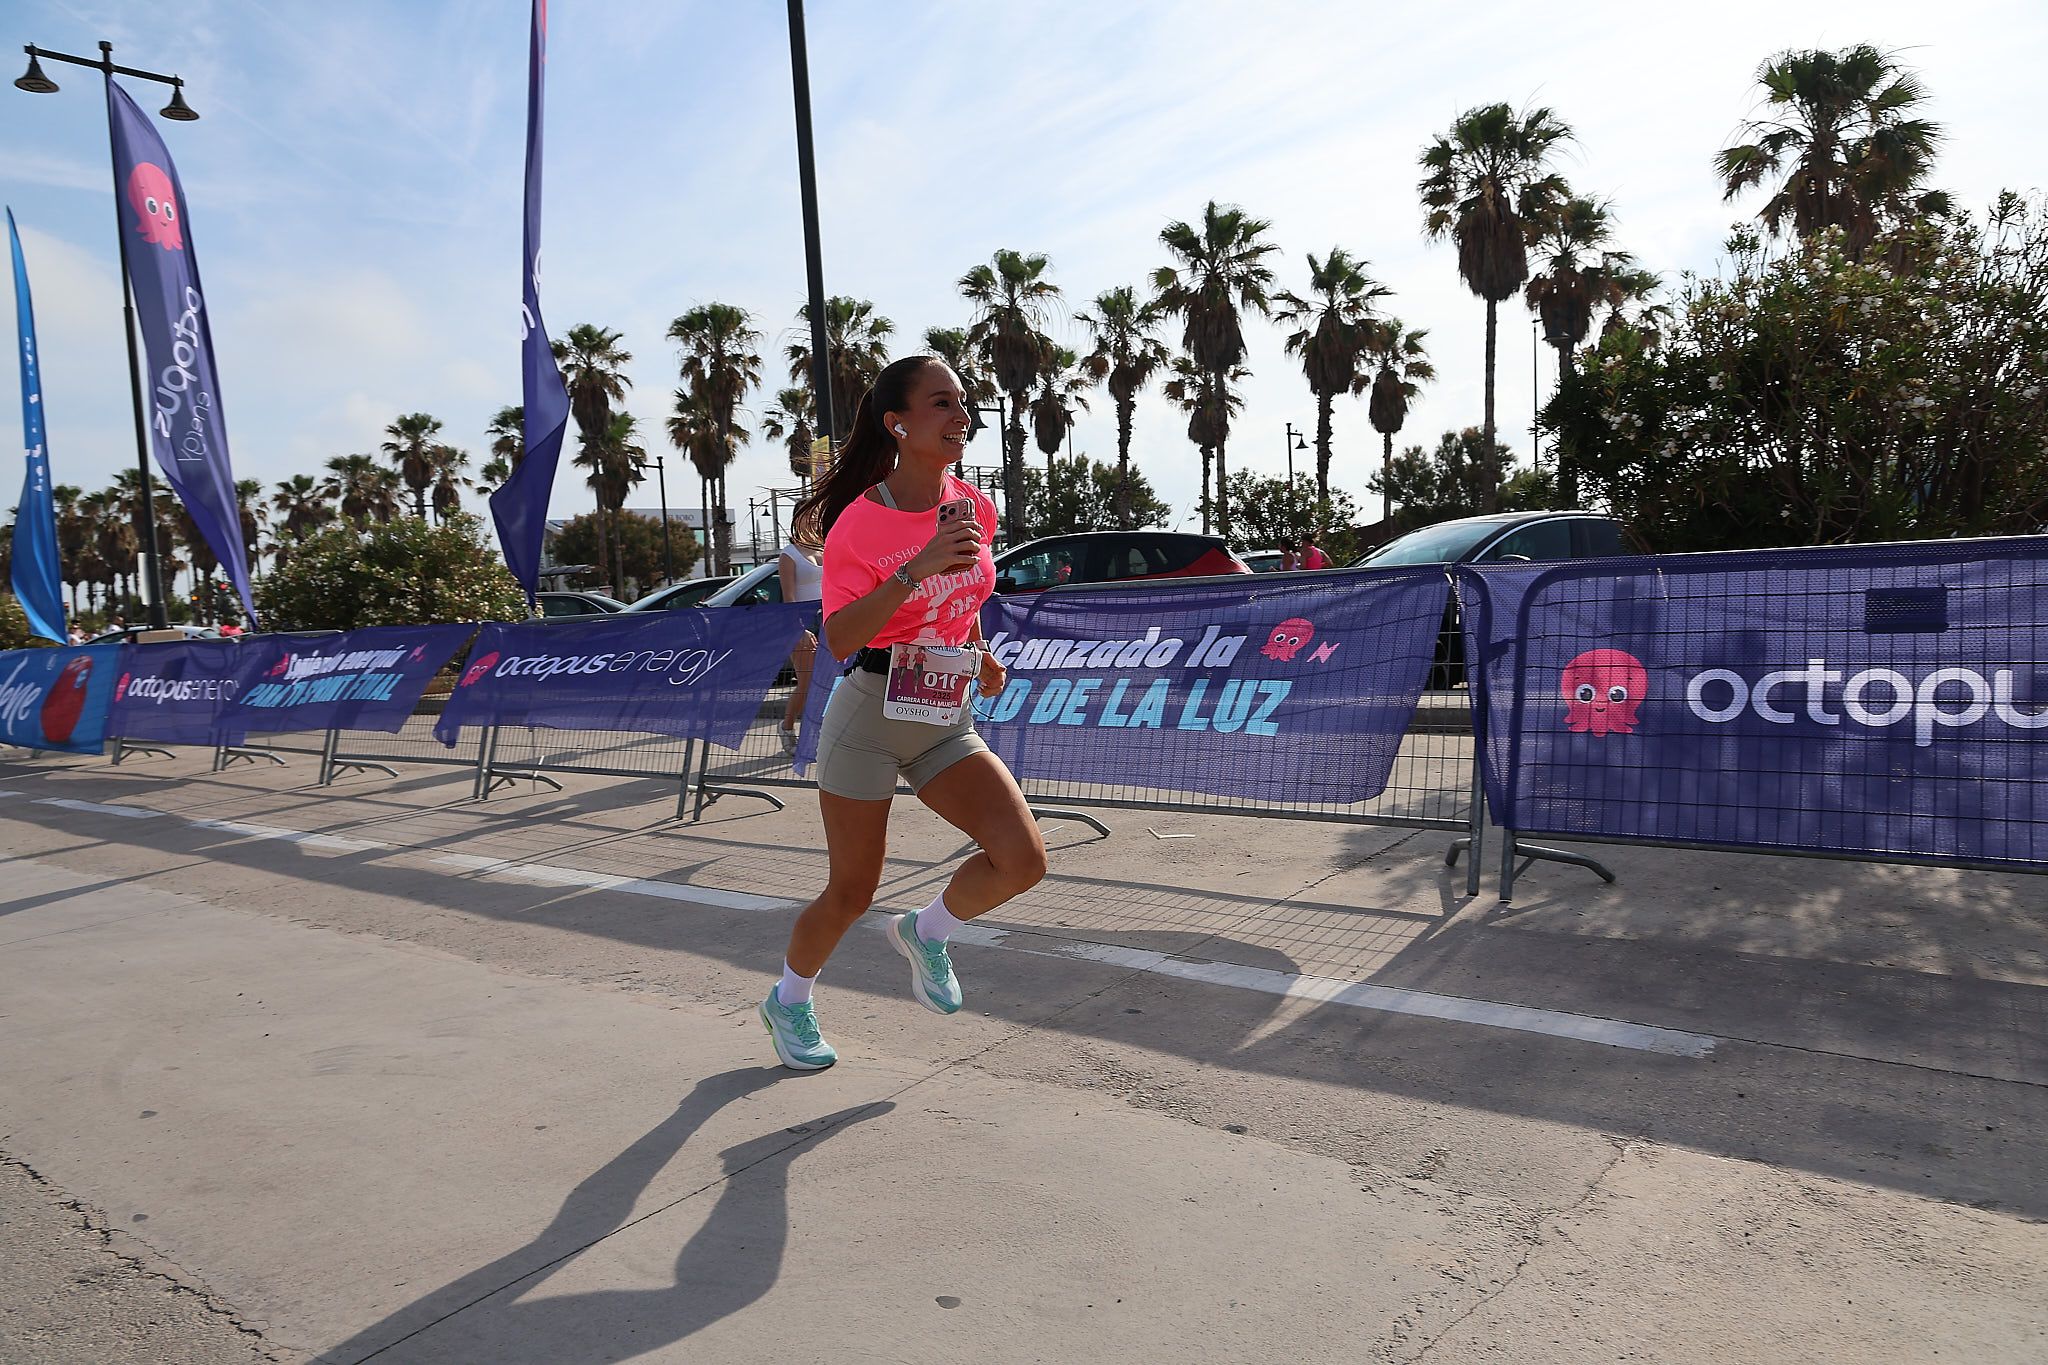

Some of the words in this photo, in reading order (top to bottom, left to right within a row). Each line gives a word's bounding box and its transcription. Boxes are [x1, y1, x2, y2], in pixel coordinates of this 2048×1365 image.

[878, 545, 922, 568] OYSHO
[987, 626, 1184, 669] lcanzado
[1185, 625, 1248, 668] la
[896, 695, 921, 704] CARRERA
[1029, 678, 1104, 725] DE
[1097, 678, 1171, 729] LA
[1177, 678, 1293, 737] LUZ
[896, 706, 930, 718] OYSHO
